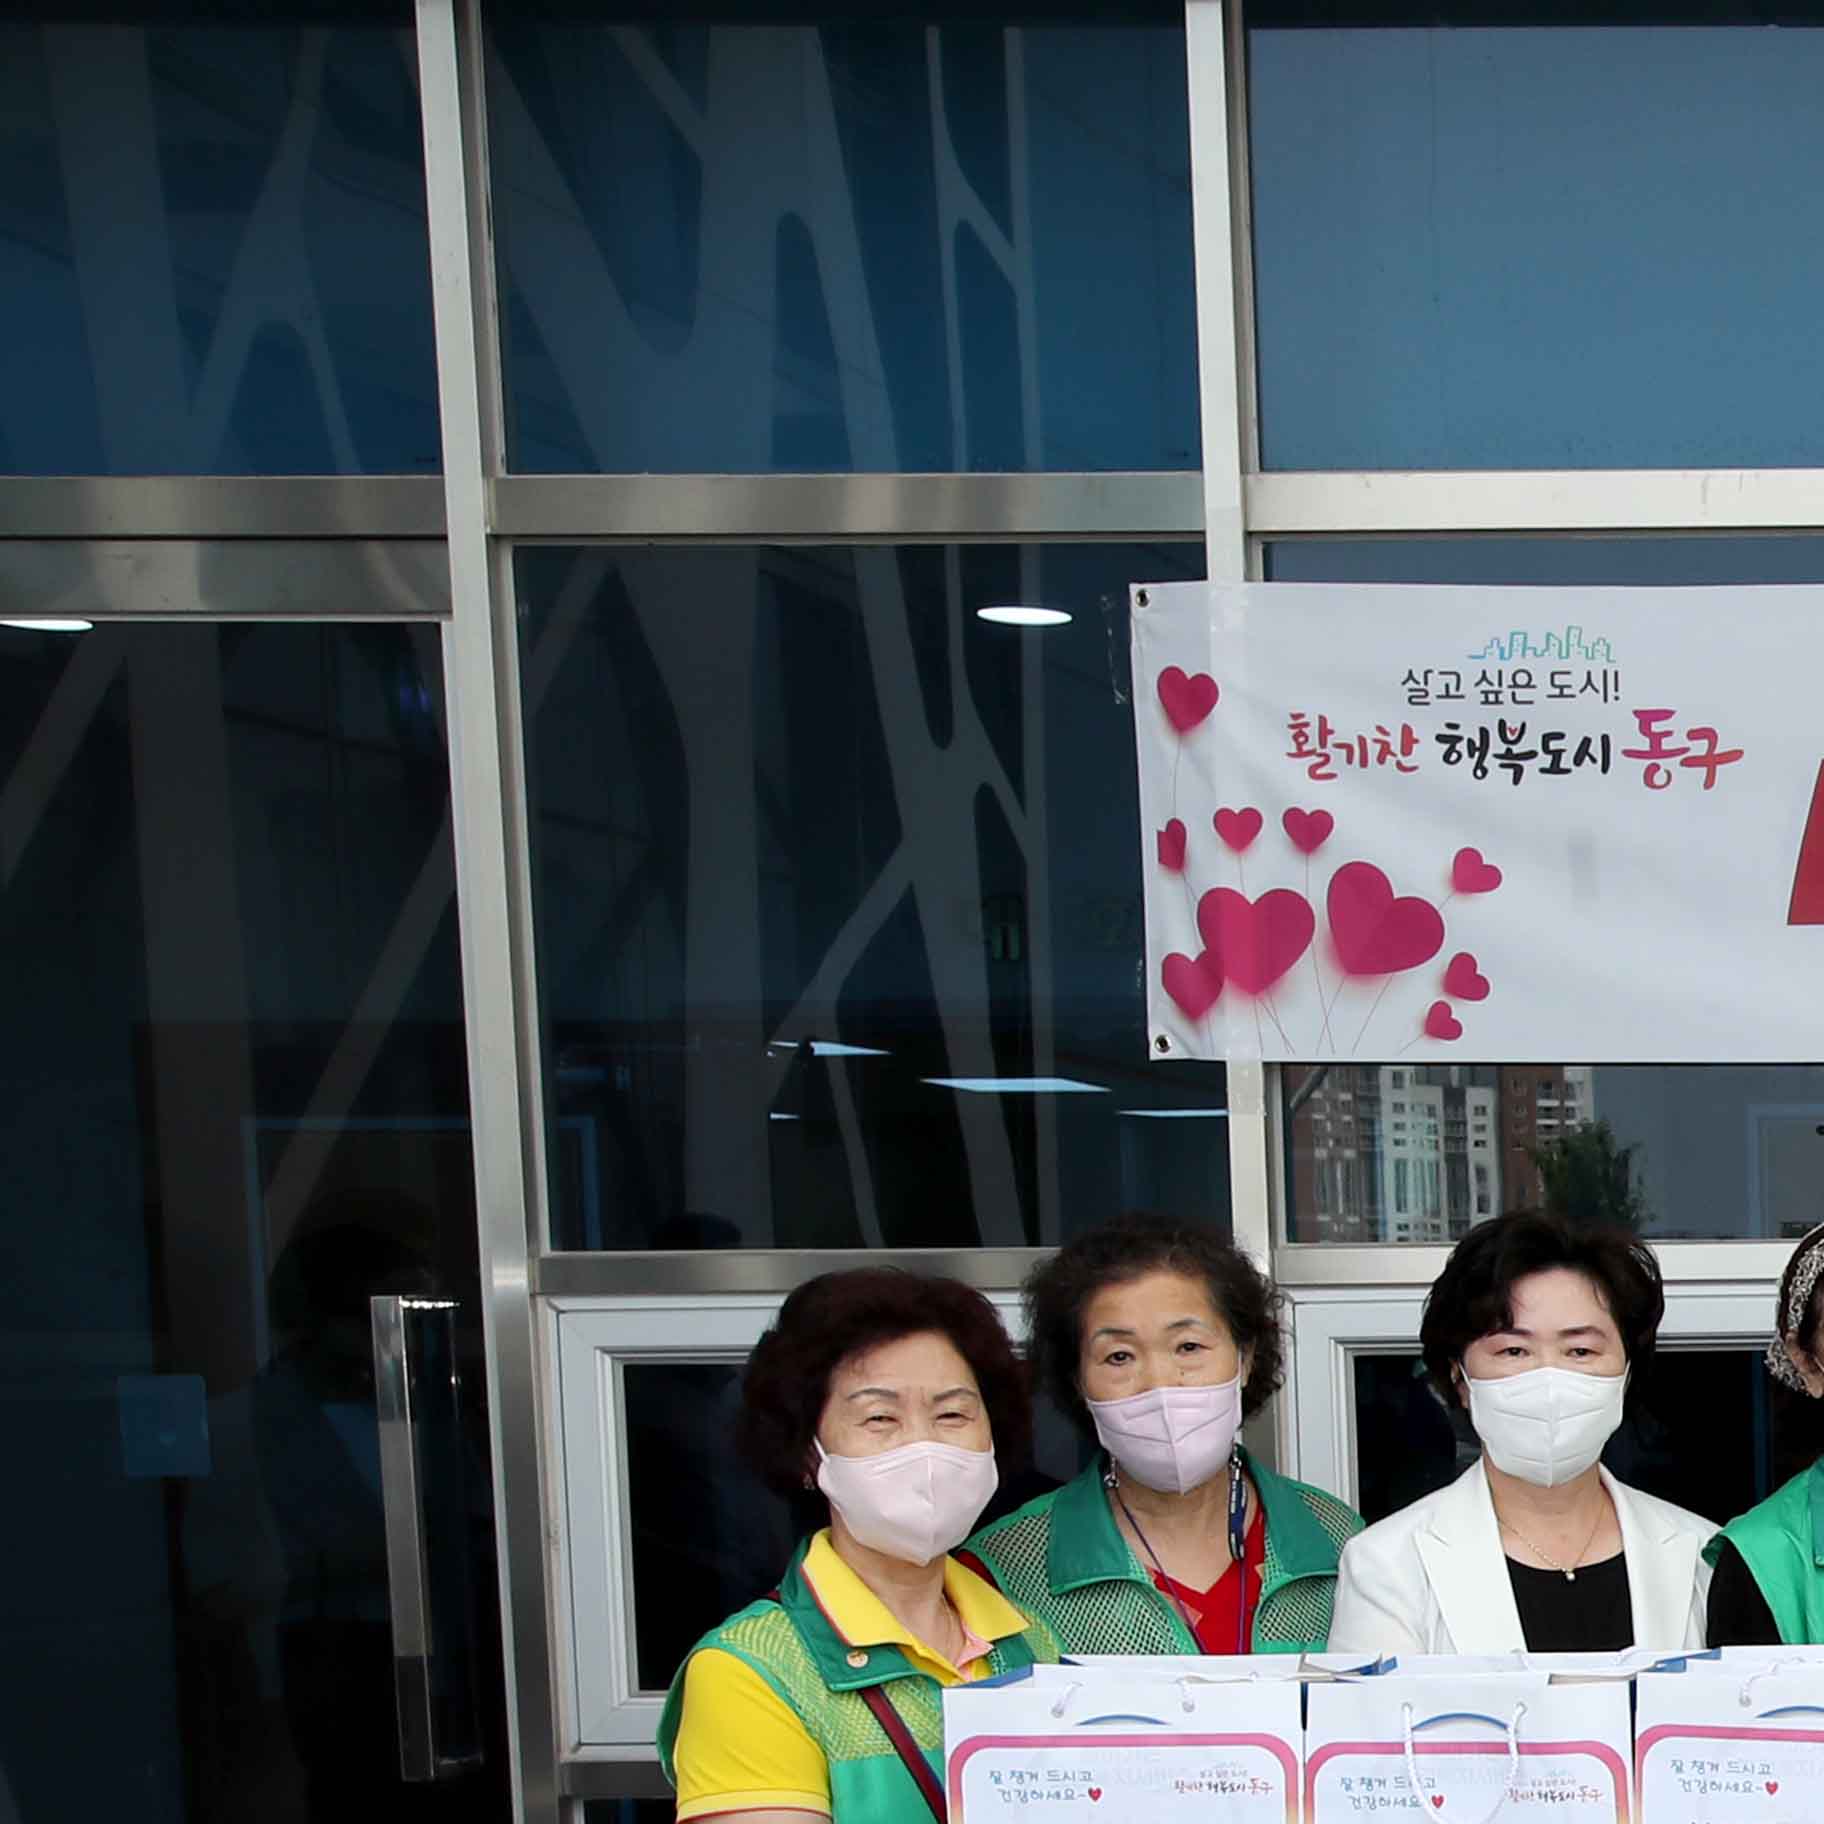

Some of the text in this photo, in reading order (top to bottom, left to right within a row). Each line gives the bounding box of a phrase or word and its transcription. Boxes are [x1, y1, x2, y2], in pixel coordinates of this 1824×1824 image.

[1401, 669, 1619, 706] 살고 싶은 도시!
[1285, 709, 1745, 790] 활기찬 행복도시 동구
